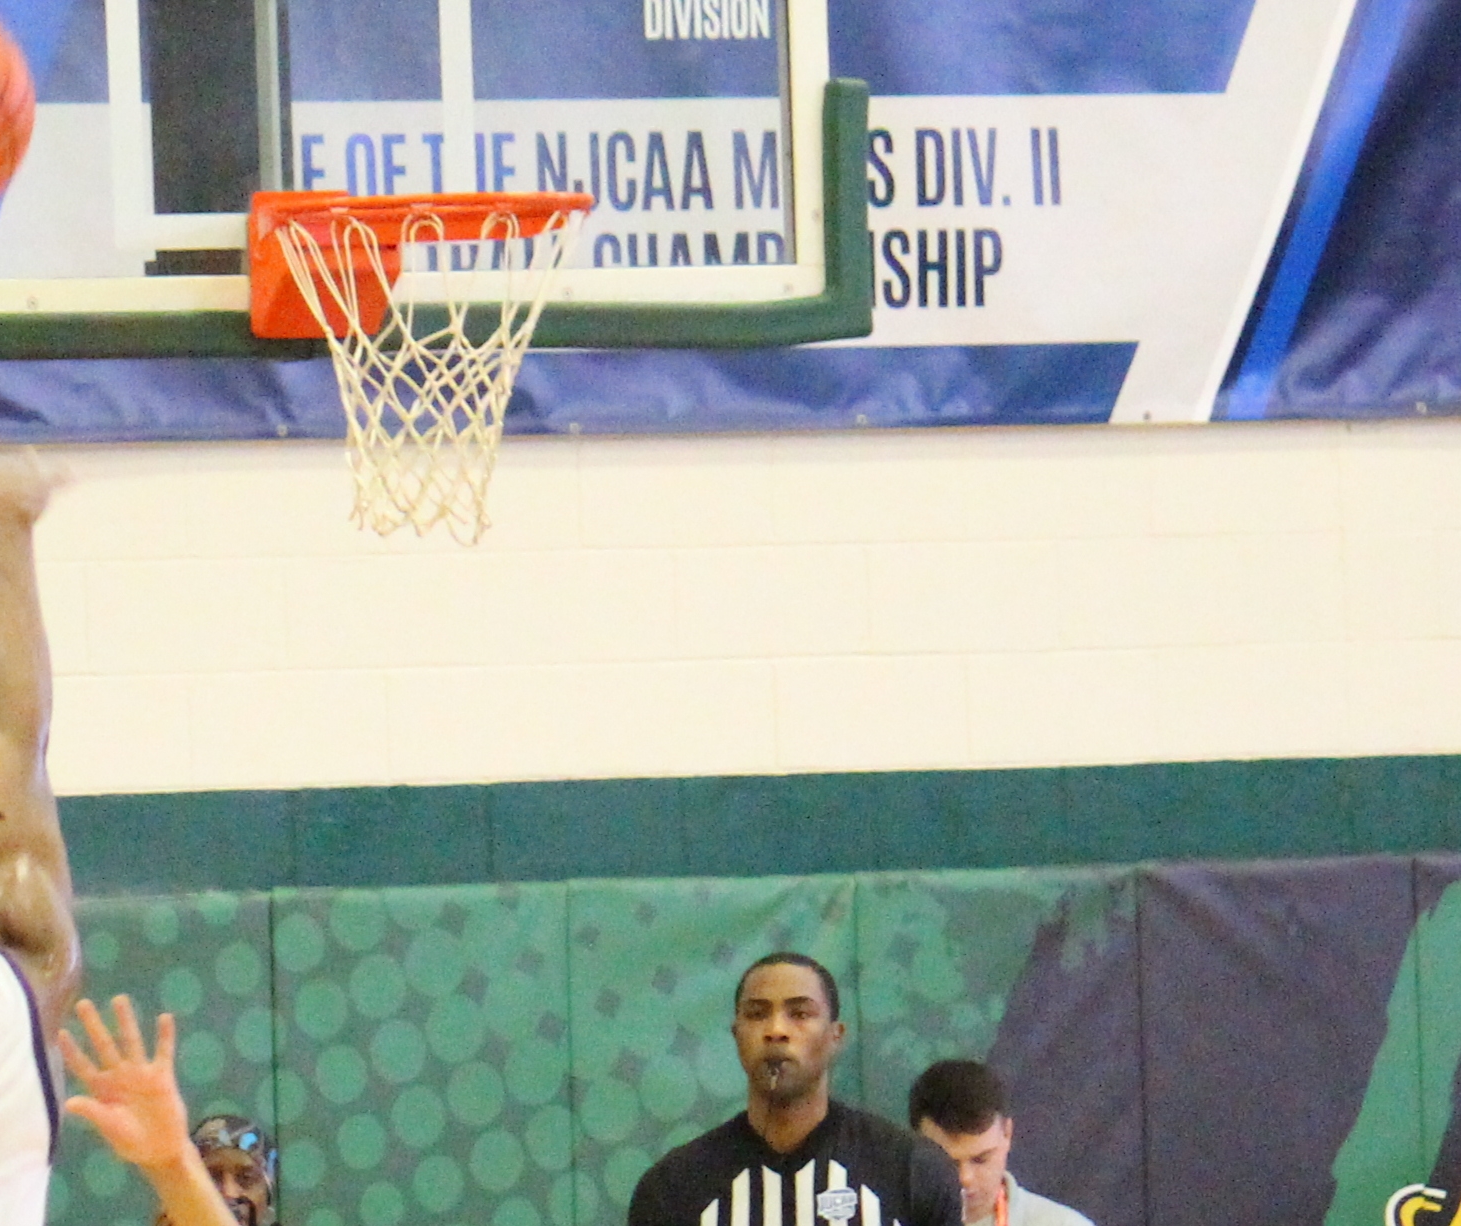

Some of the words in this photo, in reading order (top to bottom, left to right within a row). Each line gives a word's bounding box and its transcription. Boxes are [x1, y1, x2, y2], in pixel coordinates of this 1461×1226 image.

[642, 0, 773, 40] DIVISION
[345, 133, 407, 196] OF
[535, 130, 715, 212] NJCAA
[915, 127, 1012, 209] DIV.
[1029, 127, 1063, 207] II
